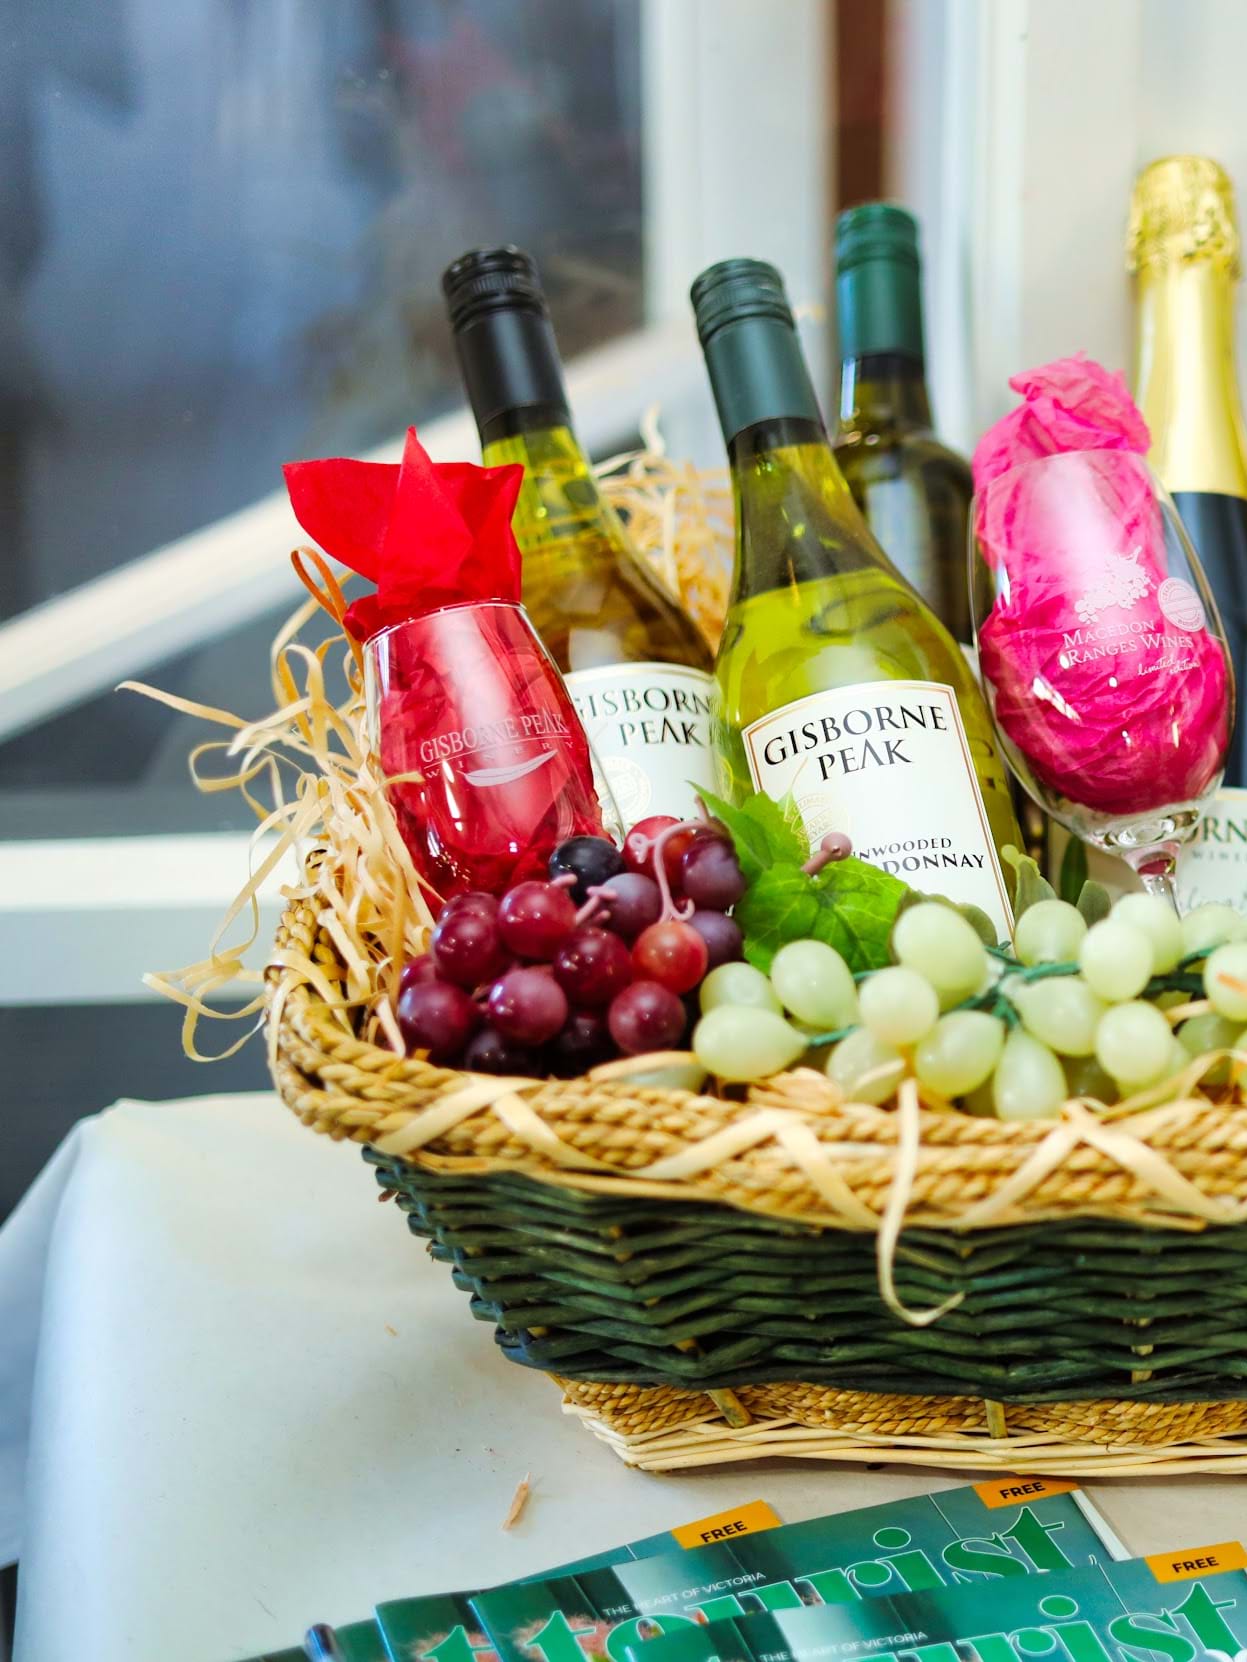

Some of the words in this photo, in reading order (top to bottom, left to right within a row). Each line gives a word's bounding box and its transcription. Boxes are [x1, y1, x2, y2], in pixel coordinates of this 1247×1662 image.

[1062, 620, 1156, 648] MACEDON
[1066, 639, 1138, 667] RANGES
[1139, 633, 1195, 650] WINES
[420, 718, 520, 763] GISBORNE
[519, 706, 570, 737] PEAK
[619, 715, 706, 748] PEAK
[763, 704, 948, 766] GISBORNE
[816, 738, 912, 781] PEAK
[1000, 1481, 1046, 1500] FREE
[700, 1520, 748, 1543] FREE
[1172, 1556, 1219, 1574] FREE
[603, 1604, 633, 1617] THE
[681, 1587, 701, 1599] OF
[702, 1571, 767, 1593] VICTORIA
[841, 1641, 861, 1652] OF
[862, 1631, 929, 1650] VICTORIA
